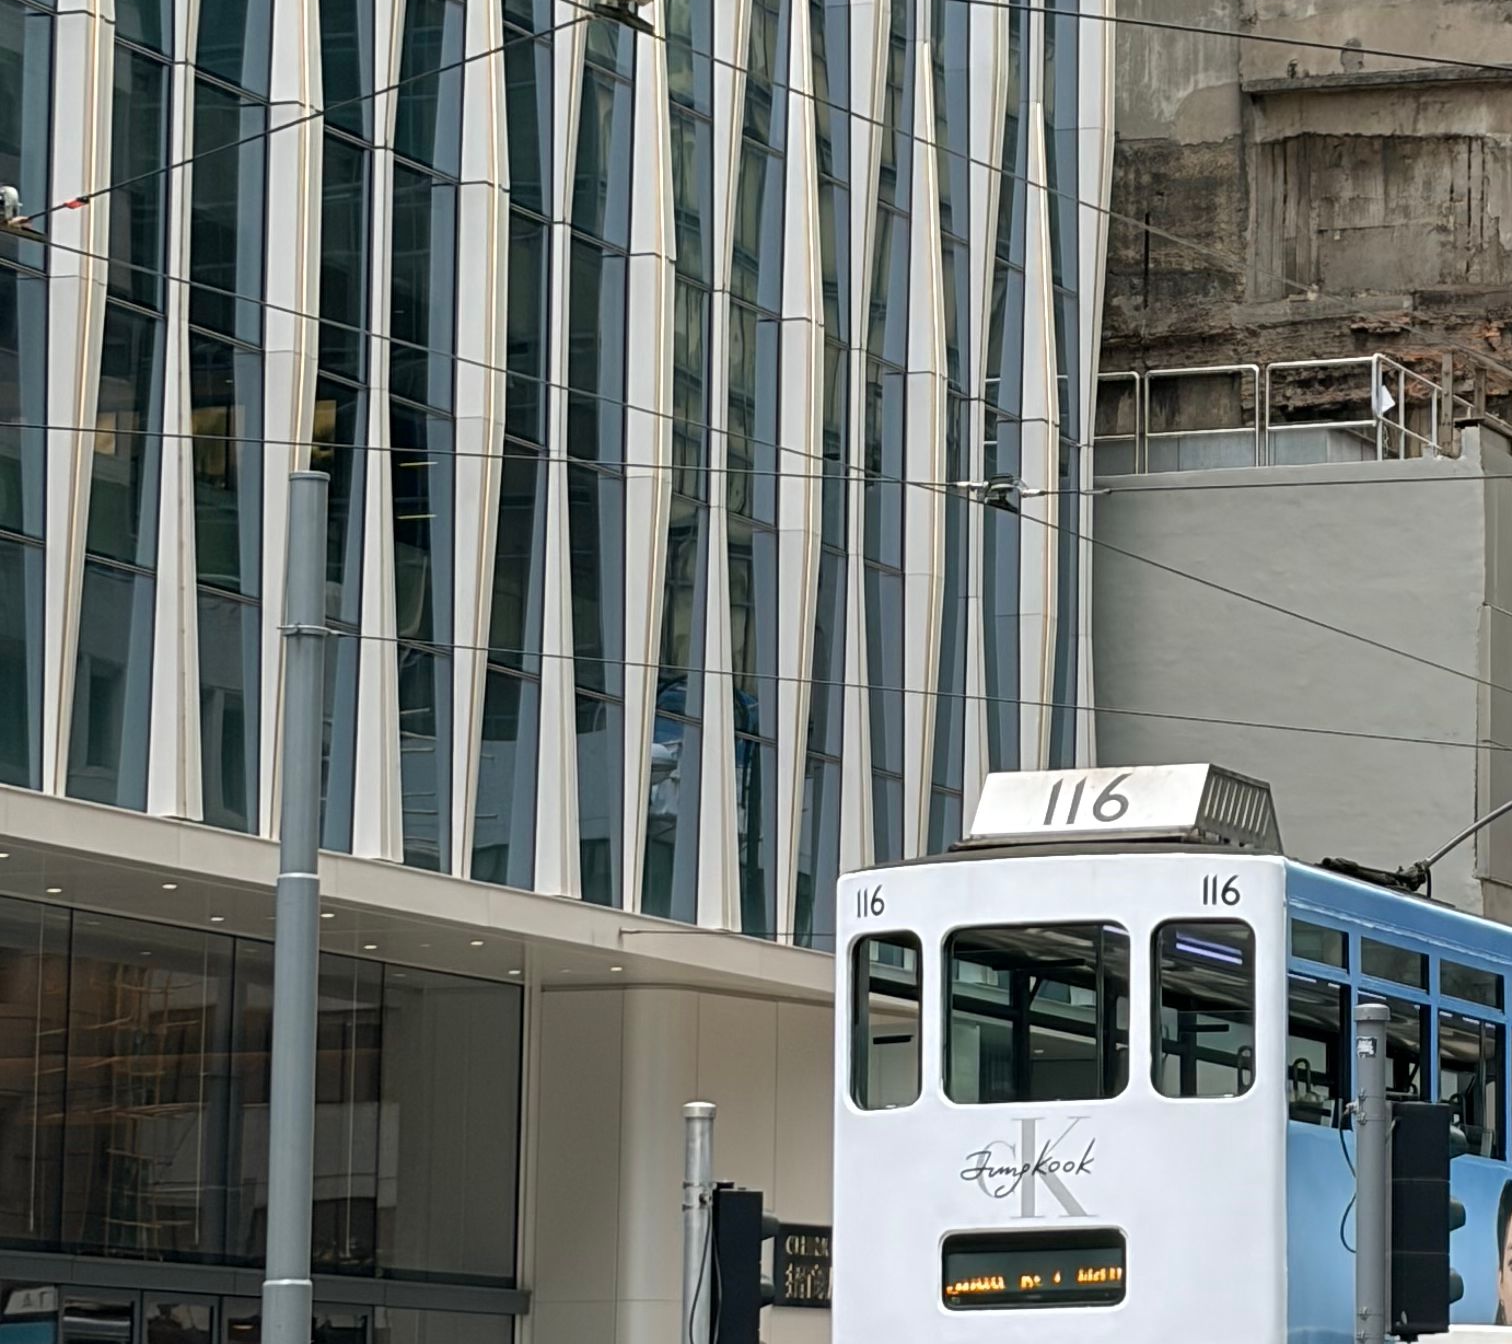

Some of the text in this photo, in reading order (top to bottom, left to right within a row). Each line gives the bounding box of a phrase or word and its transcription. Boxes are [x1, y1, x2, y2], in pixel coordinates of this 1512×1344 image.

[1043, 772, 1130, 827] 116
[856, 884, 886, 918] 116
[1201, 874, 1241, 907] 116
